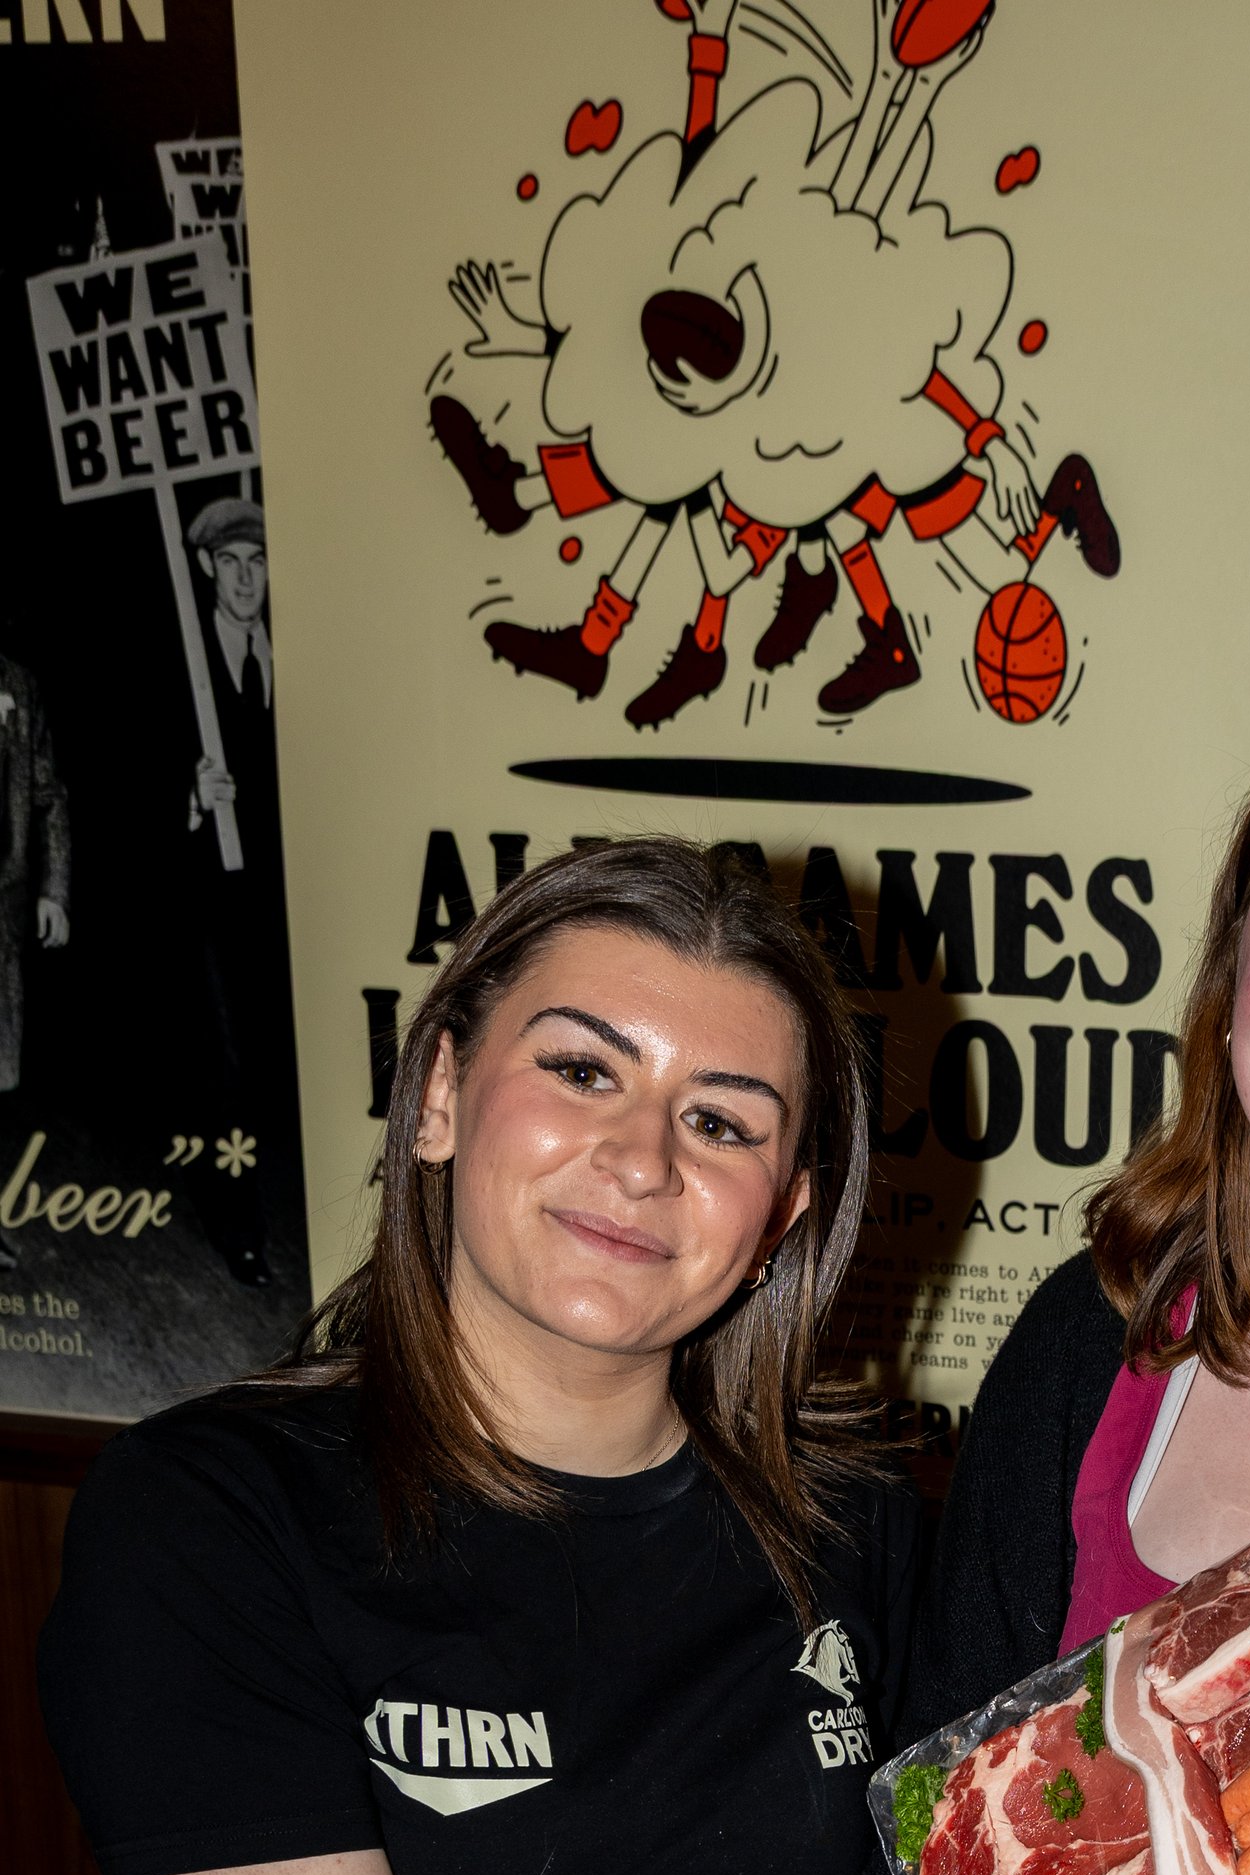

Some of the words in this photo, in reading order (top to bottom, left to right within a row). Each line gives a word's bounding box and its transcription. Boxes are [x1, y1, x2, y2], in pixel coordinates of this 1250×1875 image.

[54, 251, 207, 338] WE
[48, 310, 229, 416] WANT
[61, 389, 254, 490] BEER
[706, 842, 1162, 1005] AMES
[963, 1198, 1060, 1236] ACT
[927, 1259, 989, 1279] comes
[998, 1264, 1019, 1281] to
[32, 1290, 80, 1320] the
[959, 1285, 1009, 1305] right
[952, 1307, 986, 1325] live
[890, 1326, 944, 1344] cheer
[953, 1332, 977, 1348] on
[910, 1351, 969, 1370] teams
[807, 1705, 868, 1732] CARLTON
[811, 1726, 875, 1770] DRY
